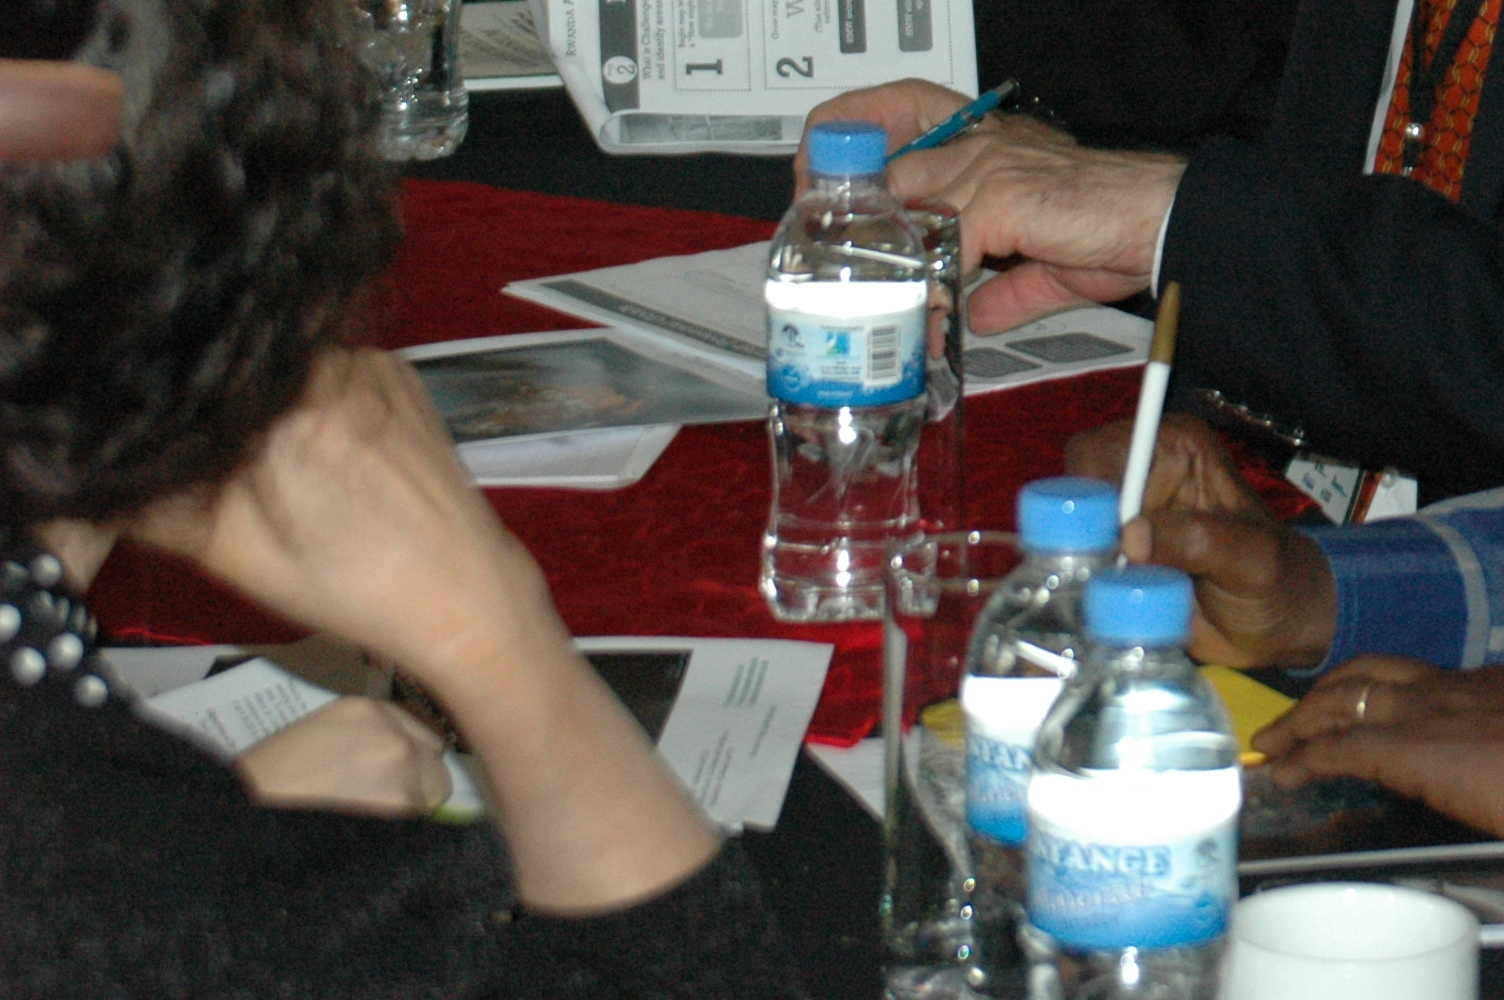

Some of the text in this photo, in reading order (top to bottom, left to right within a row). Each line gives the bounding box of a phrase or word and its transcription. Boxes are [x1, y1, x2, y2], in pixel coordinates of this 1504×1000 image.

[565, 8, 577, 57] RWANDA
[653, 28, 667, 60] identify
[616, 64, 637, 75] 2
[641, 57, 652, 79] What
[656, 64, 666, 79] and
[686, 60, 723, 75] 1
[776, 56, 814, 78] 2
